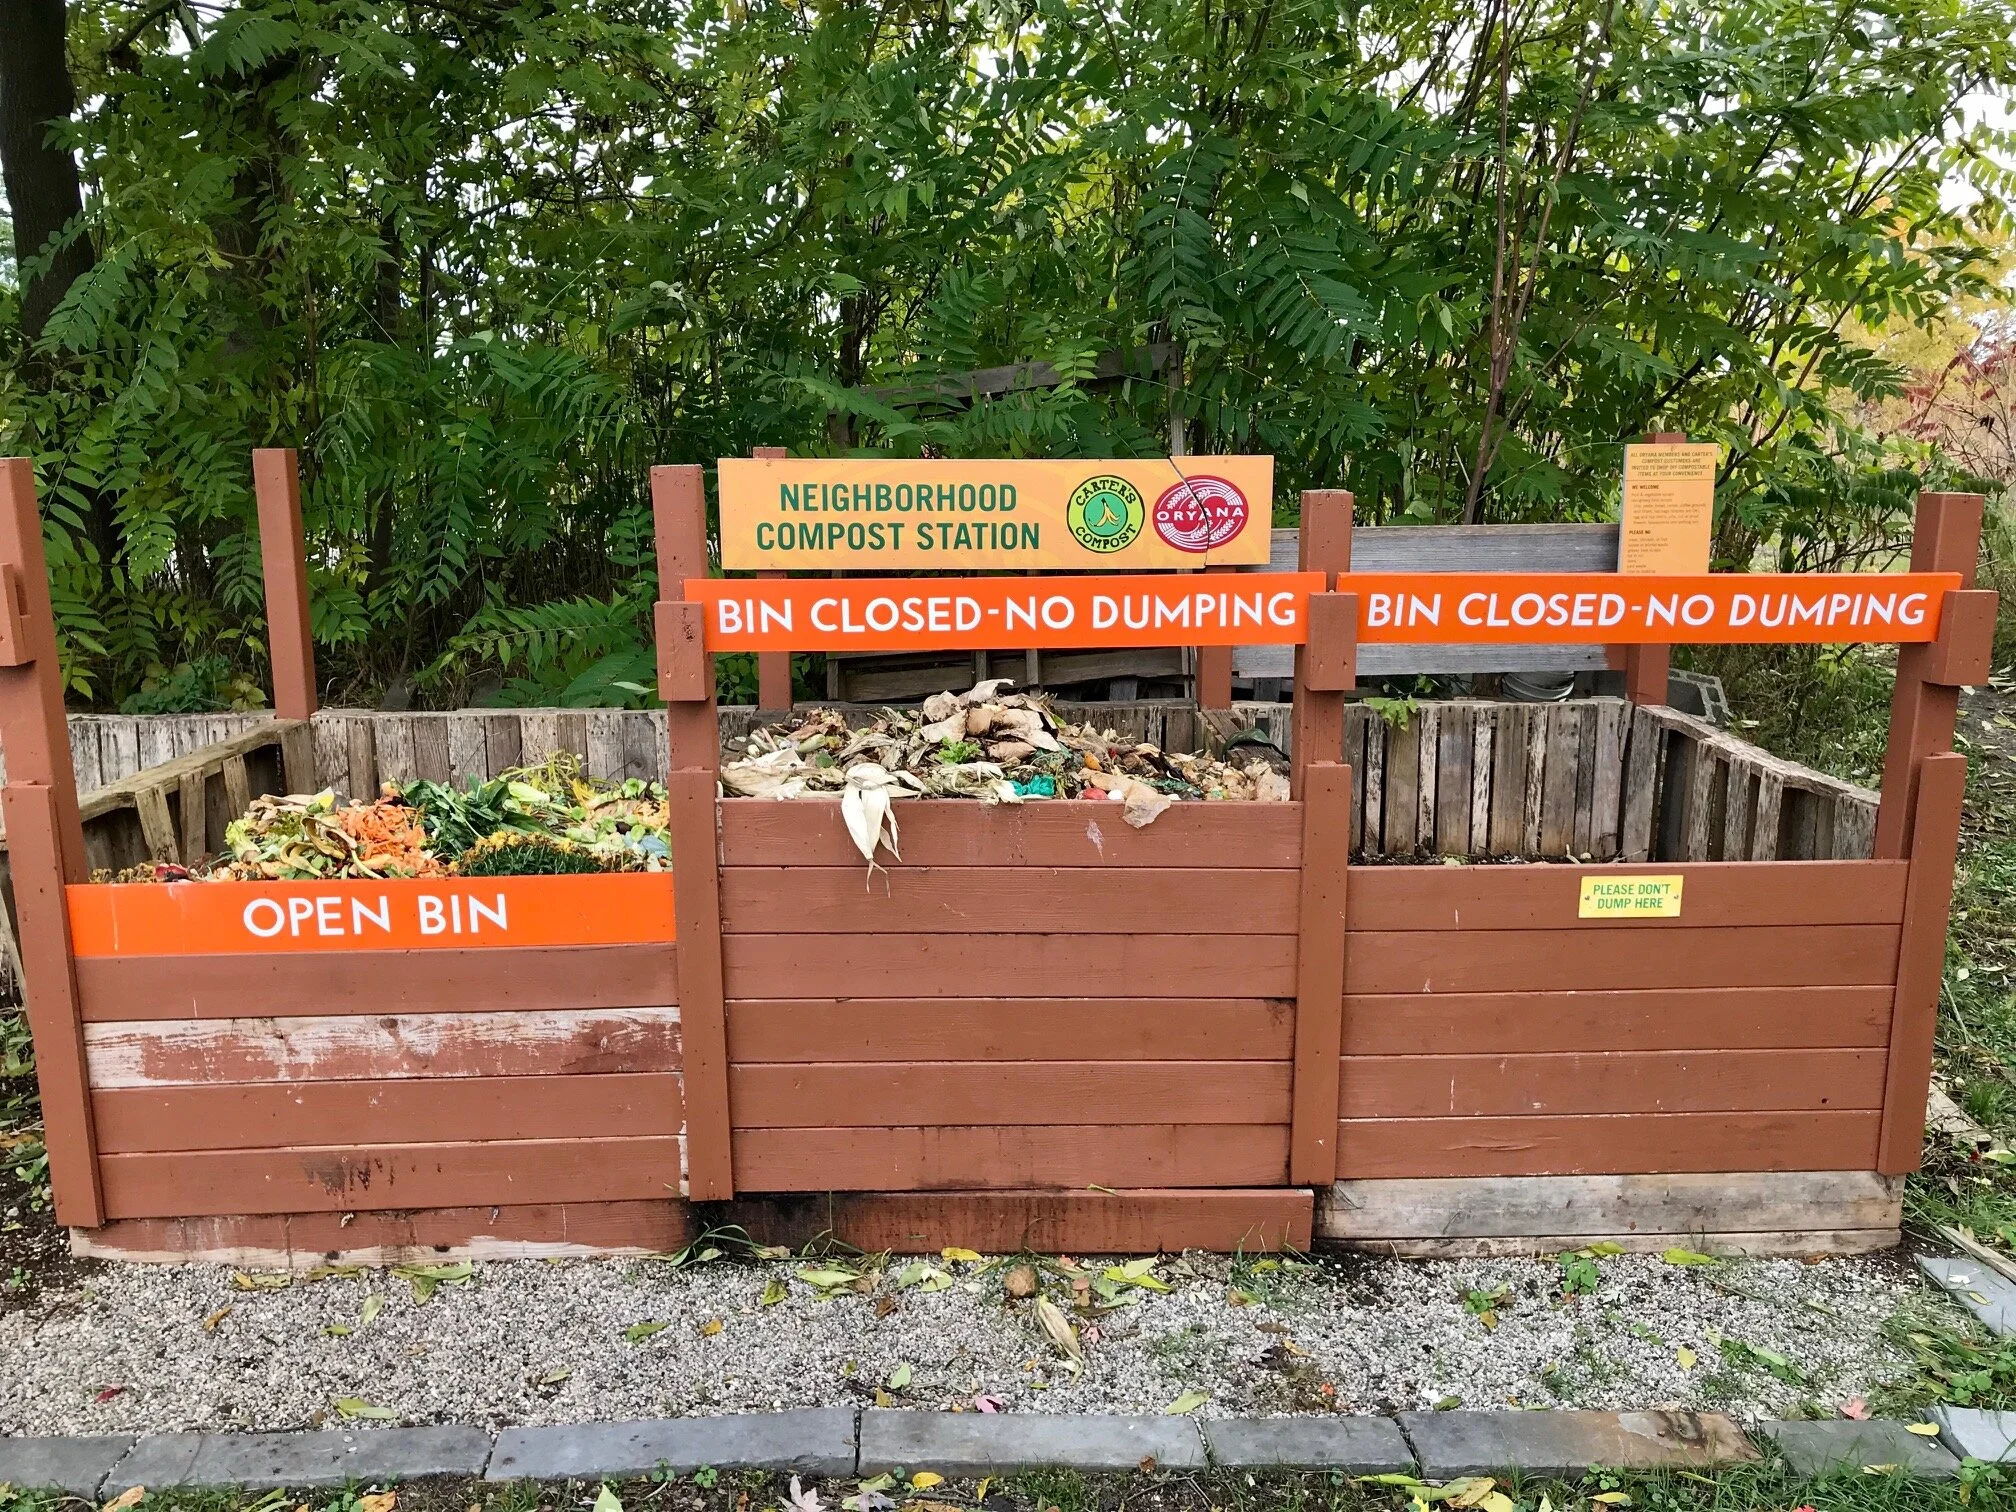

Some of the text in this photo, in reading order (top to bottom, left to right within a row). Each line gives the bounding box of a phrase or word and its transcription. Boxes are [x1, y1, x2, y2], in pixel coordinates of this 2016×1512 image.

[780, 483, 1017, 512] NEIGHBORHOOD
[1075, 479, 1137, 507] CARTER'S
[1156, 506, 1245, 521] ORYANA
[756, 522, 1040, 551] COMPOST STATION
[1075, 523, 1137, 550] COMPOST
[718, 598, 793, 634] BIN
[1092, 591, 1296, 630] DUMPING
[1367, 593, 1442, 627] BIN
[1728, 592, 1928, 628] DUMPING
[1593, 883, 1671, 896] PLEASE DON'T
[1597, 897, 1664, 910] DUMP HERE
[242, 893, 508, 938] OPEN BIN
